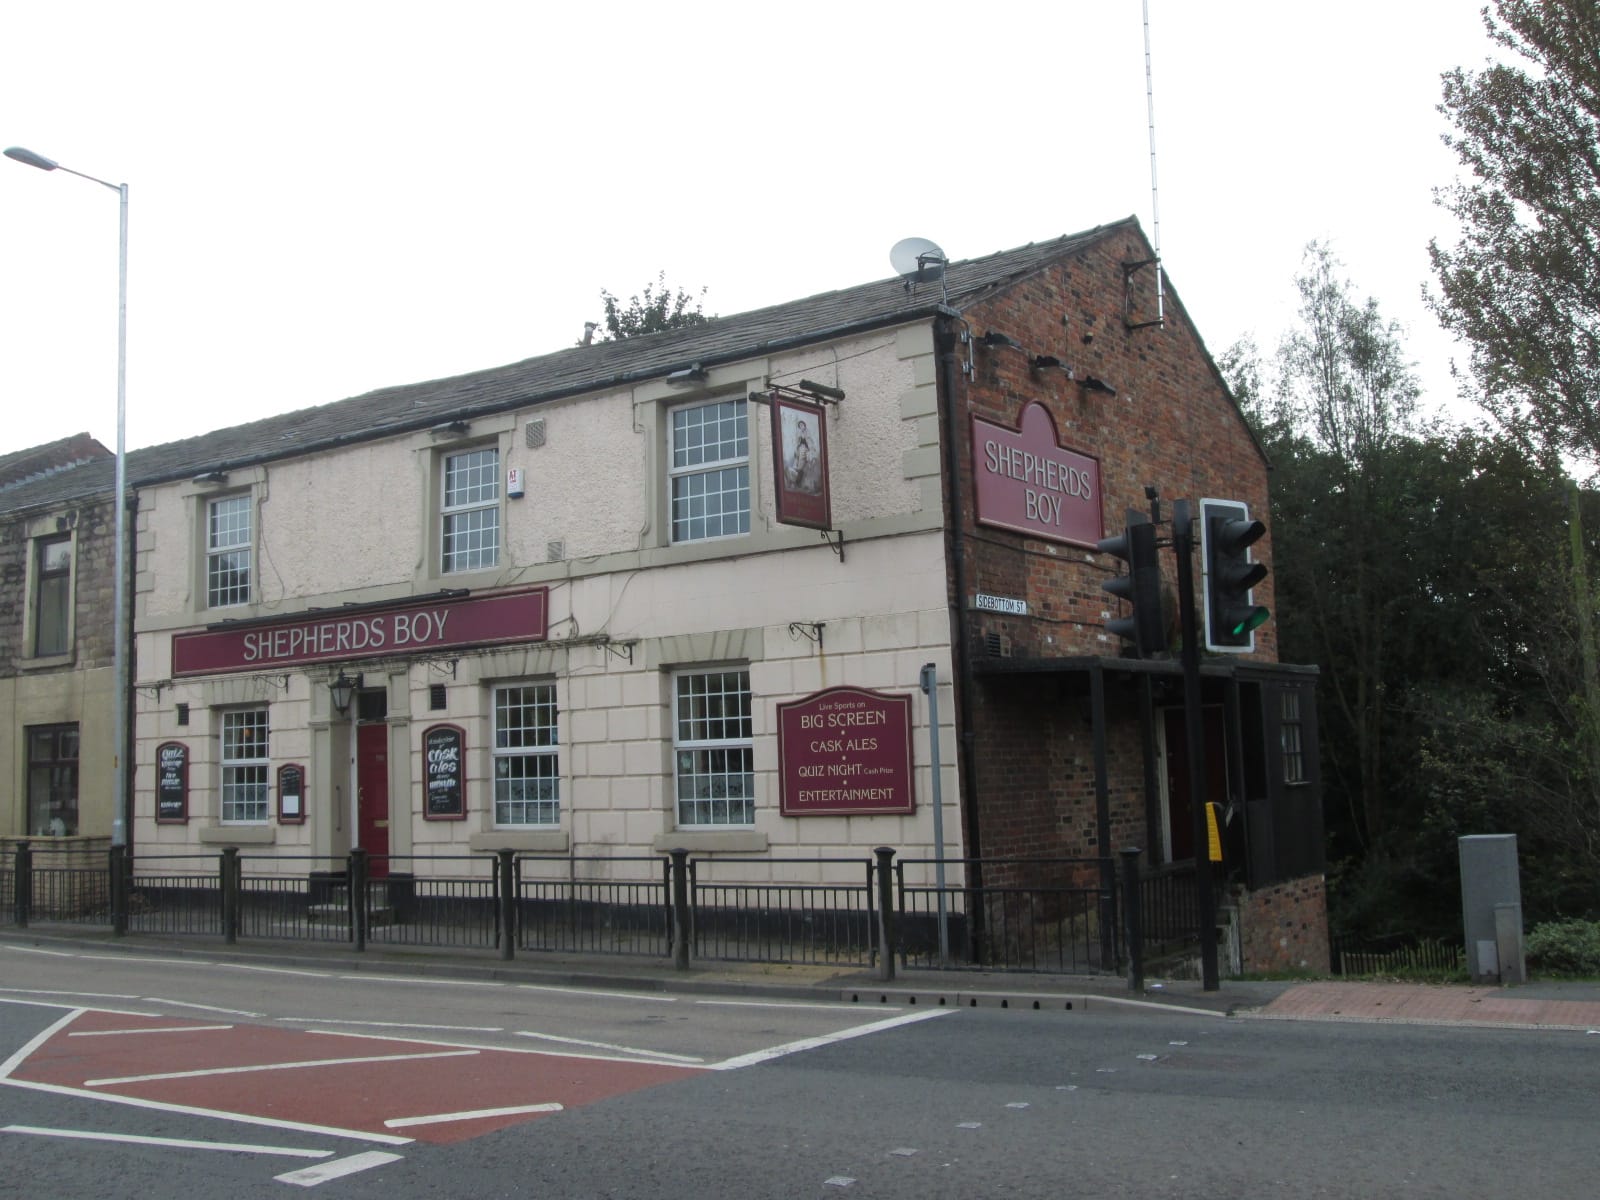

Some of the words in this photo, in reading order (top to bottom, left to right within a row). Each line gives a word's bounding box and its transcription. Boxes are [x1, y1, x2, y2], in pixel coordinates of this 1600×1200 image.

[985, 440, 1092, 500] SHEPHERDS
[1025, 488, 1062, 526] BOY
[243, 617, 385, 661] SHEPHERDS
[393, 609, 449, 645] BOY
[819, 703, 832, 711] Live
[834, 702, 856, 711] Sports
[801, 714, 824, 729] BIG
[828, 710, 886, 727] SCREEN
[810, 740, 843, 752] CASK
[846, 738, 878, 751] ALES
[798, 766, 825, 777] QUIZ
[828, 764, 863, 776] NIGHT
[799, 788, 894, 802] ENTERTAINMENT
